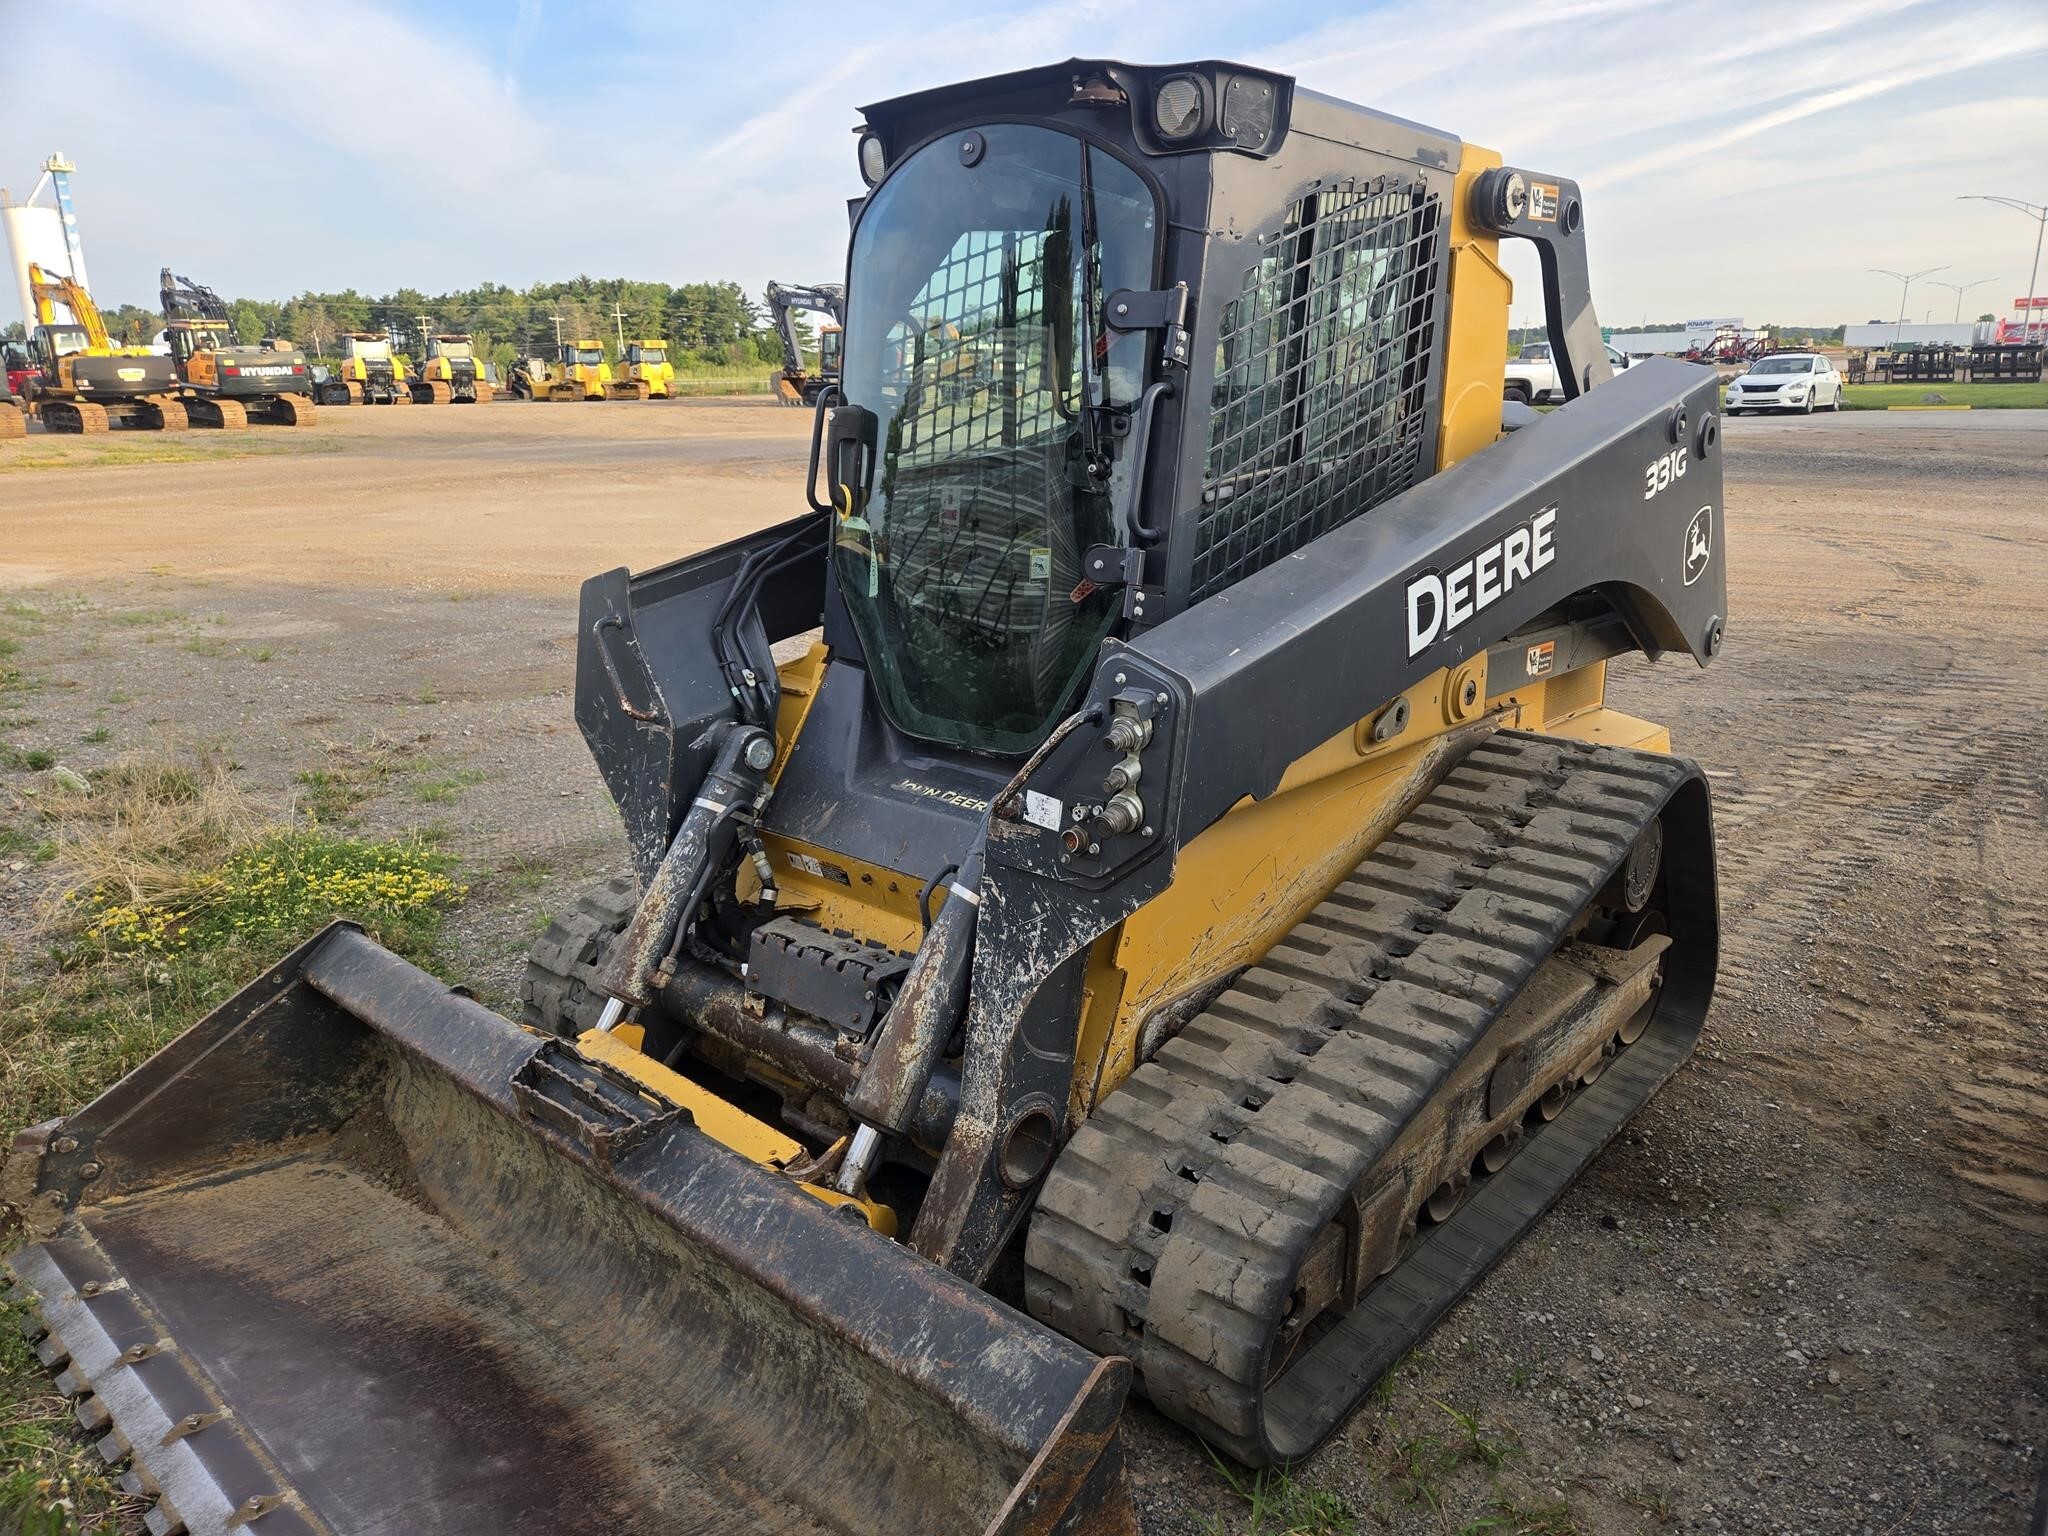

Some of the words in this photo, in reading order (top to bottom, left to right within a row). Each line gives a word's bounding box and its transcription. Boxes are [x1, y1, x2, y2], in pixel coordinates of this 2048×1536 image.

[240, 366, 293, 376] HYUNDAI
[1644, 447, 1687, 500] 331G
[1407, 508, 1556, 657] DEERE
[941, 790, 989, 812] DEER
